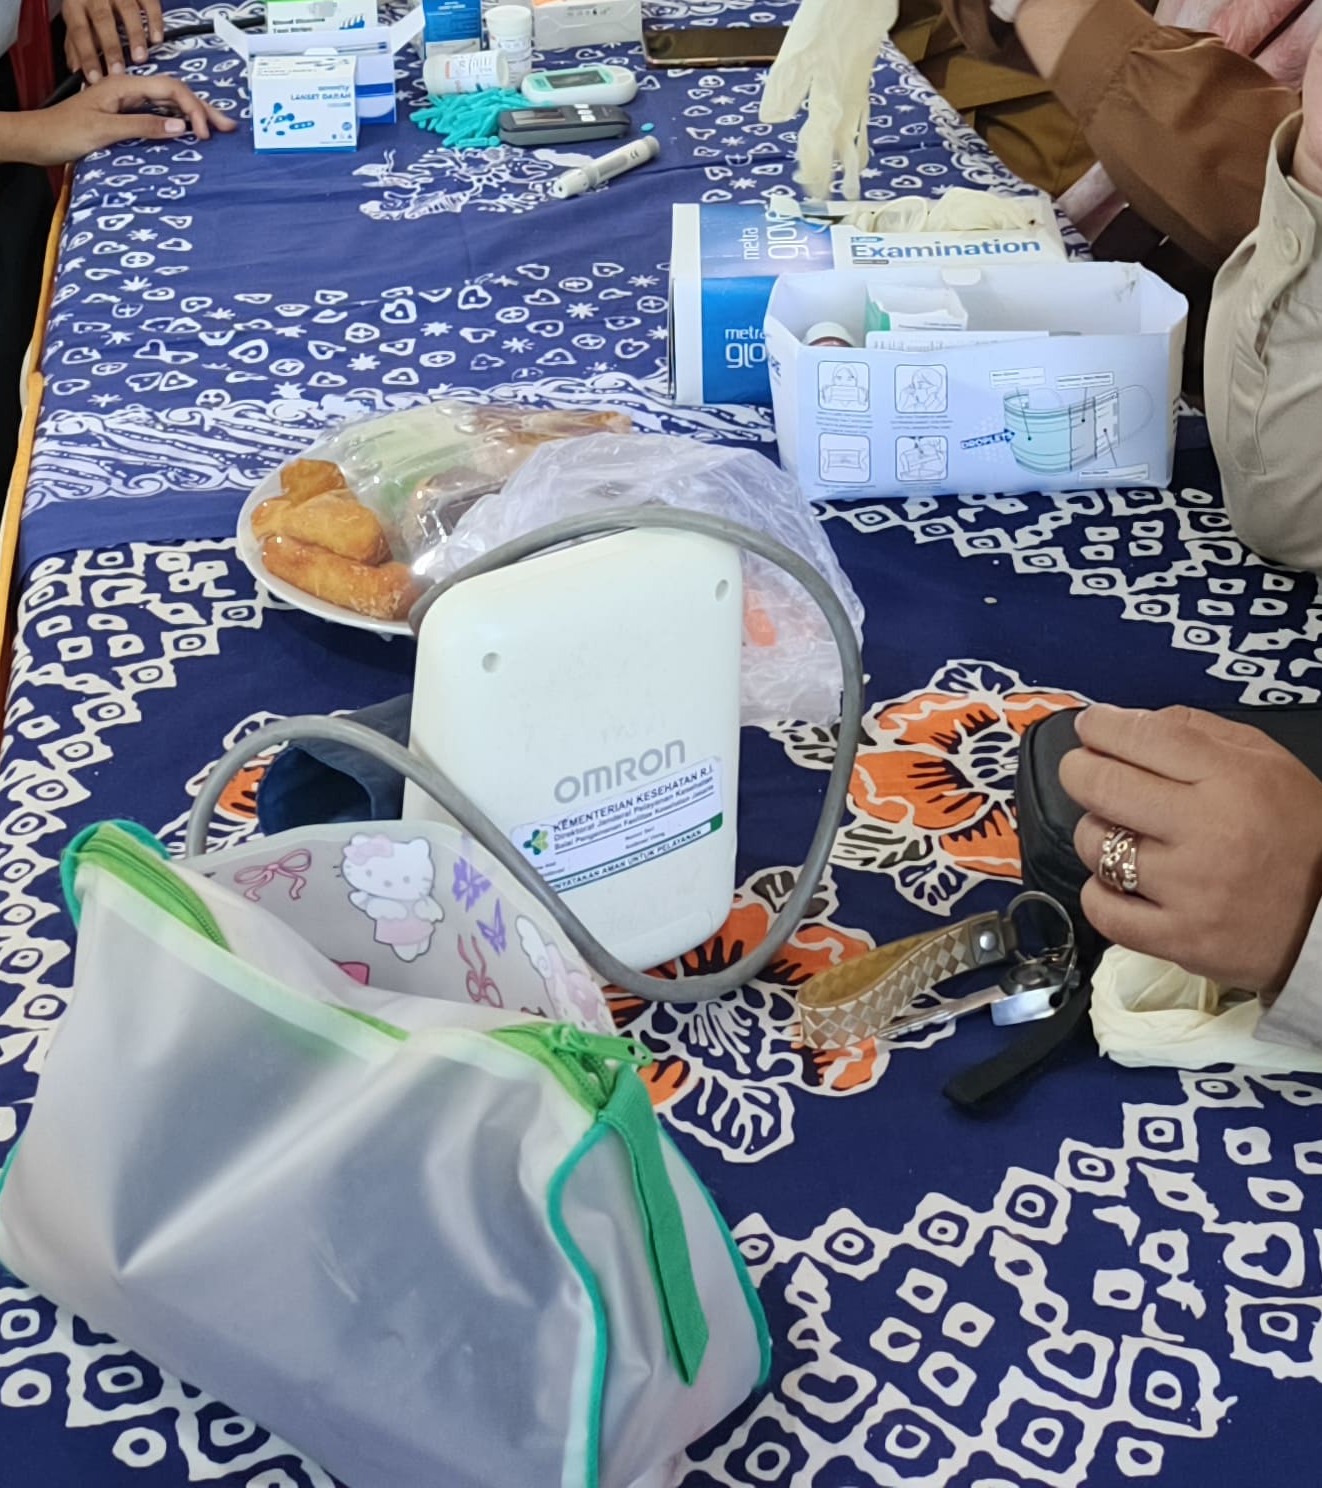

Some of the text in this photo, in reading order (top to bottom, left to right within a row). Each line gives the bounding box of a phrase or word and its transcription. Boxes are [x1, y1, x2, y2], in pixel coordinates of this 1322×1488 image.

[738, 227, 761, 260] metra
[851, 239, 1041, 258] Examination
[725, 342, 767, 369] glo
[554, 740, 686, 804] OMRON
[553, 797, 634, 832] KEMENTERIAN
[636, 771, 698, 803] KESEHATAN
